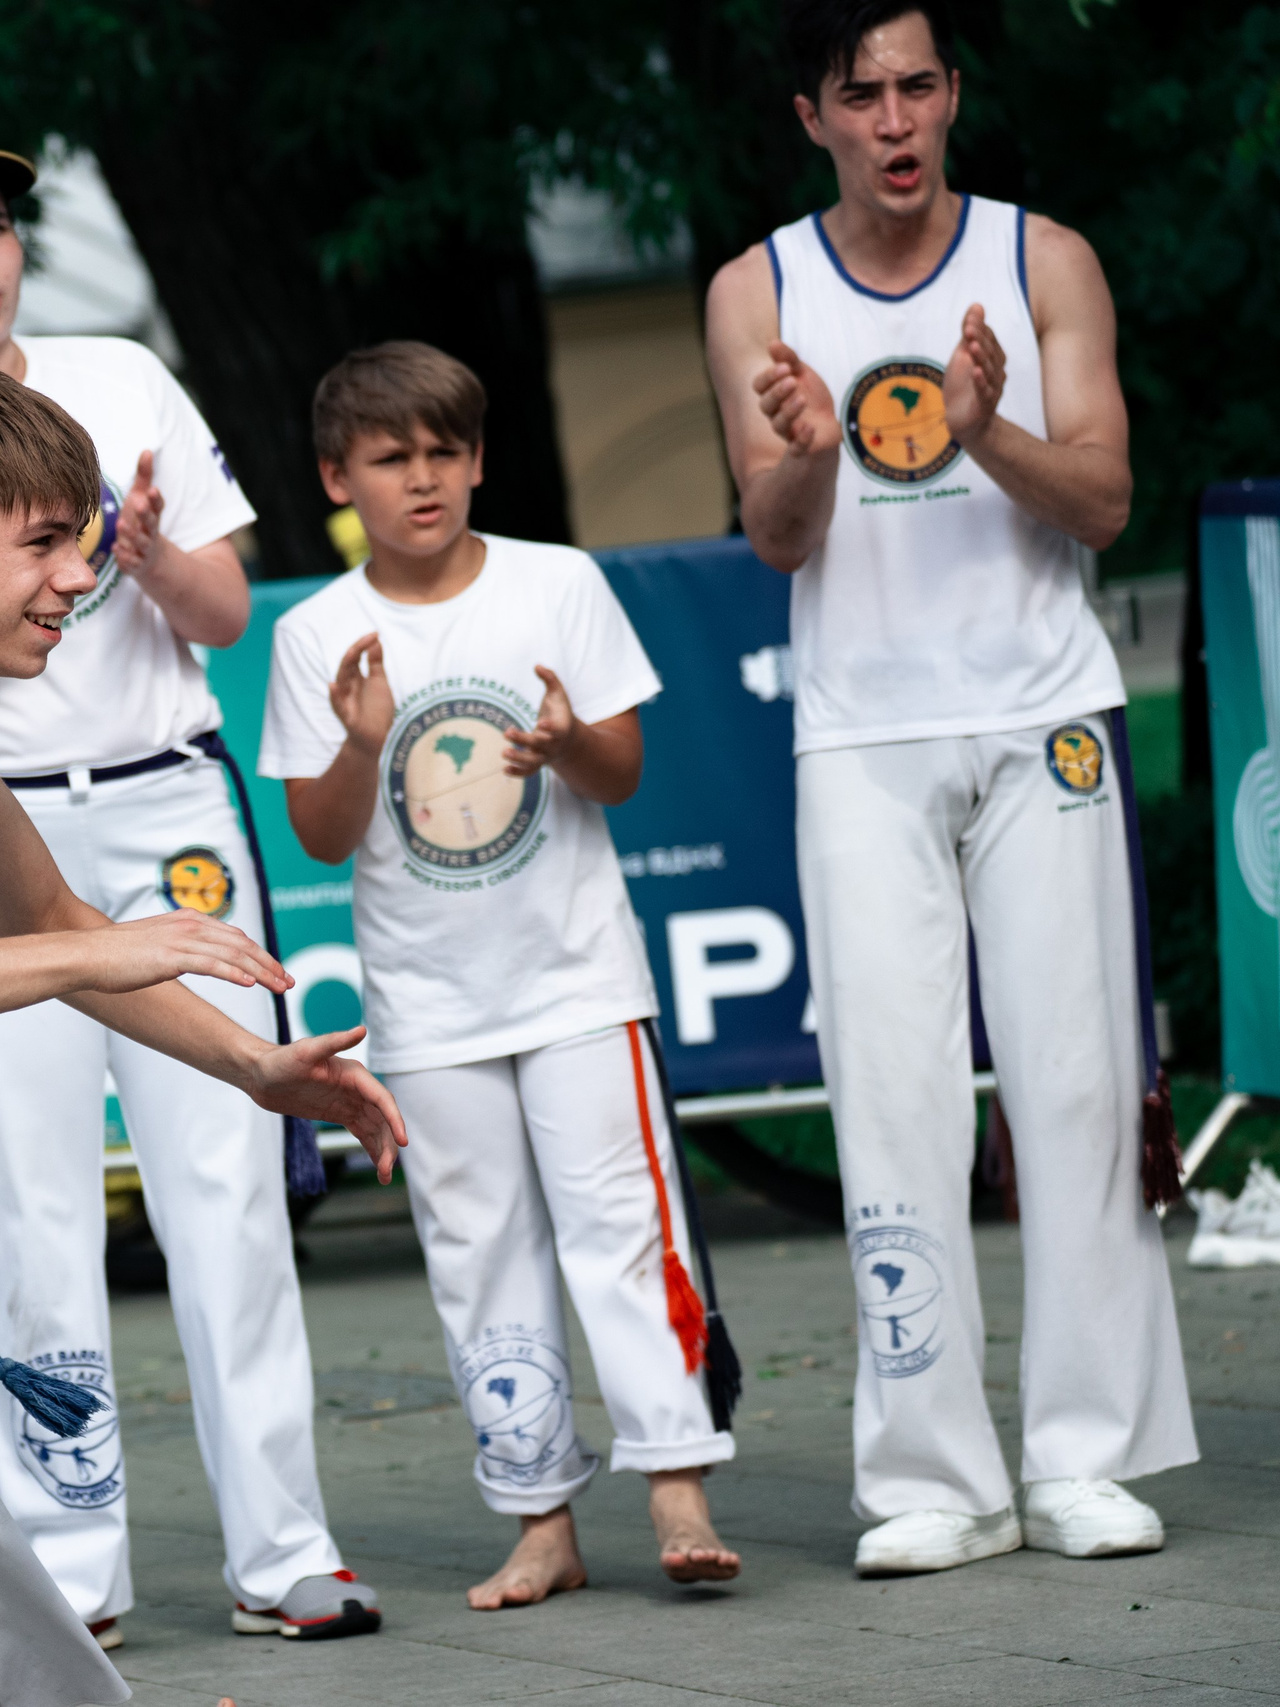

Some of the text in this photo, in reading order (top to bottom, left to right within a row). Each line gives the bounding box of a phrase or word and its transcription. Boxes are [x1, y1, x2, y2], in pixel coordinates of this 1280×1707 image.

[401, 830, 549, 893] PROFESSOR CIBORGUE
[410, 837, 471, 867] MESTRE
[56, 1478, 120, 1503] CAPOEIRA
